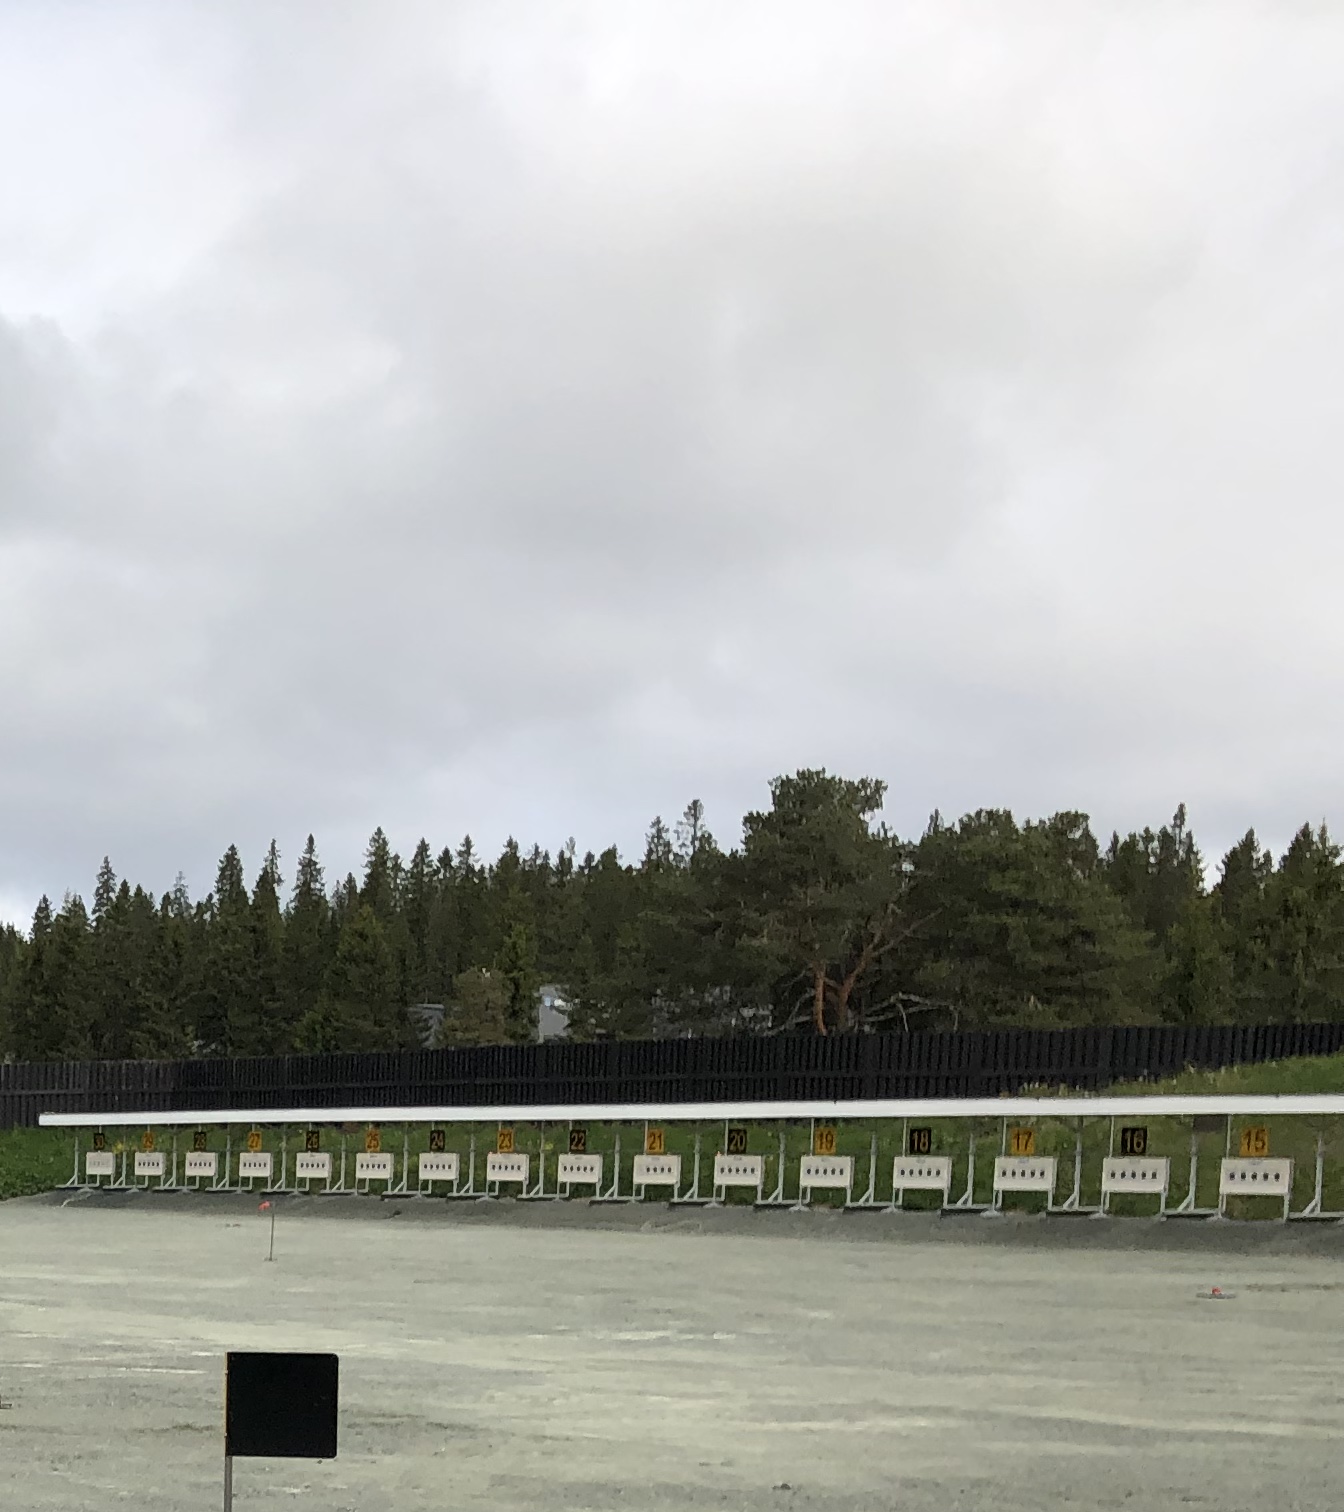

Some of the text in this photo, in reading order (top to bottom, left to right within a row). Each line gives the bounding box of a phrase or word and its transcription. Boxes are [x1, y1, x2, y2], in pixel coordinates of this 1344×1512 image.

[432, 1132, 444, 1149] 24
[499, 1132, 512, 1149] 23
[571, 1133, 585, 1150] 22
[649, 1132, 662, 1150] 21
[730, 1133, 745, 1149] 20
[818, 1131, 834, 1151] 19
[912, 1130, 928, 1152] 18
[1014, 1130, 1031, 1151] 17
[1125, 1130, 1143, 1152] 16
[1243, 1129, 1266, 1152] 15
